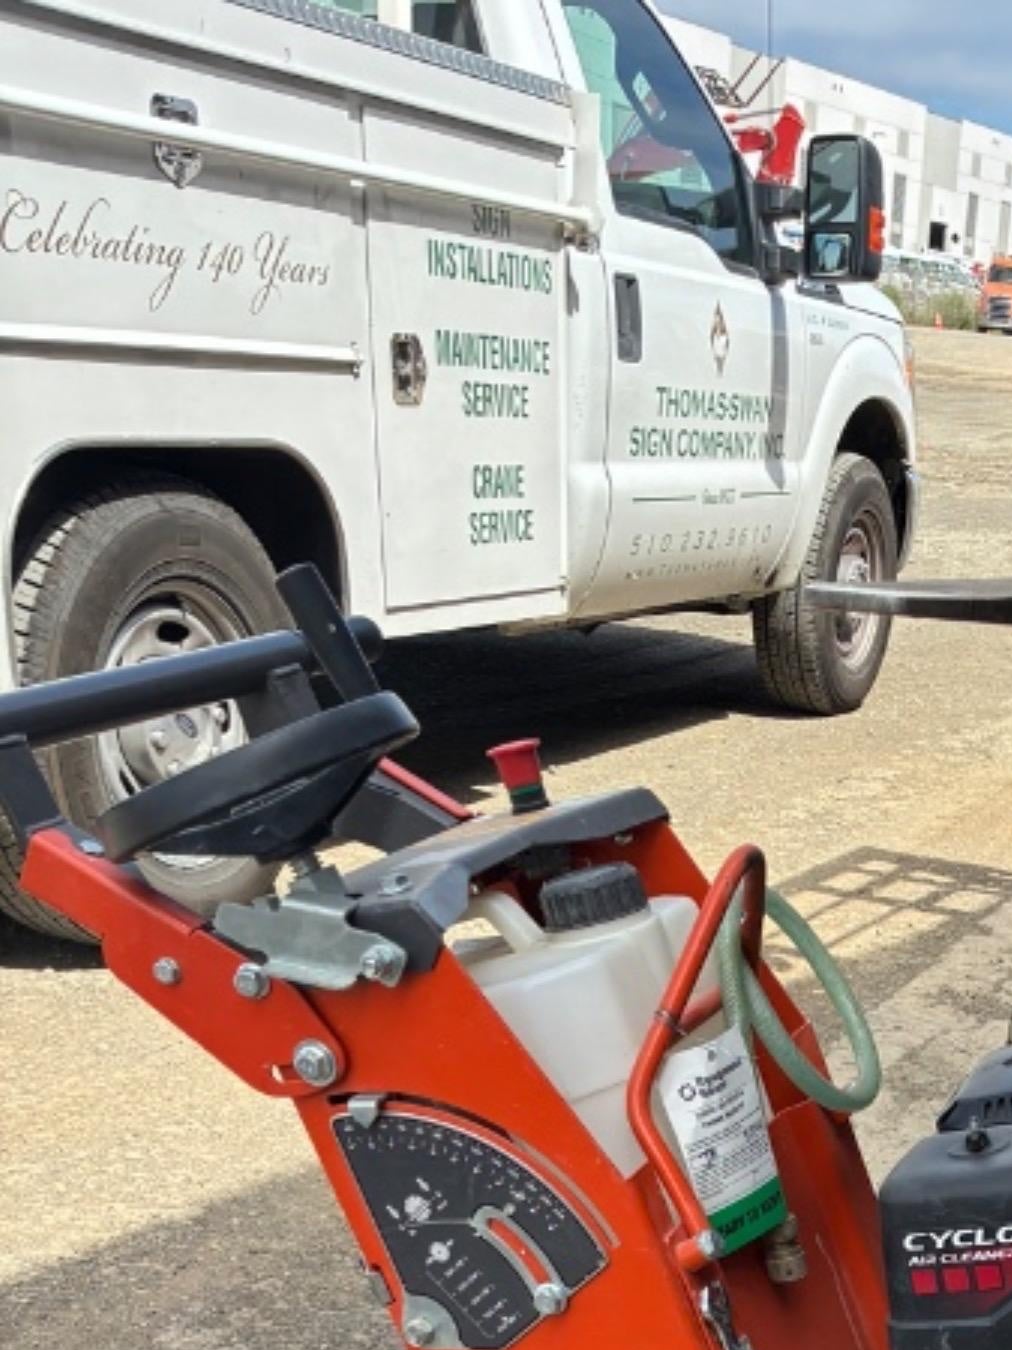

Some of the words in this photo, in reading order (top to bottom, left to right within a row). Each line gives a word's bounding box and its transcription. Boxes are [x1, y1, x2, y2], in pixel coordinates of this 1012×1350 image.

[470, 203, 511, 238] SIGN
[0, 188, 185, 312] Celebrating
[197, 239, 244, 283] 140
[250, 230, 331, 315] Years
[426, 239, 552, 295] INSTALLATIONS
[434, 328, 550, 375] MAINTENANCE
[462, 380, 529, 418] SERVICE
[629, 425, 673, 457] SIGN
[472, 464, 525, 499] CRANE
[469, 508, 534, 545] SERVICE
